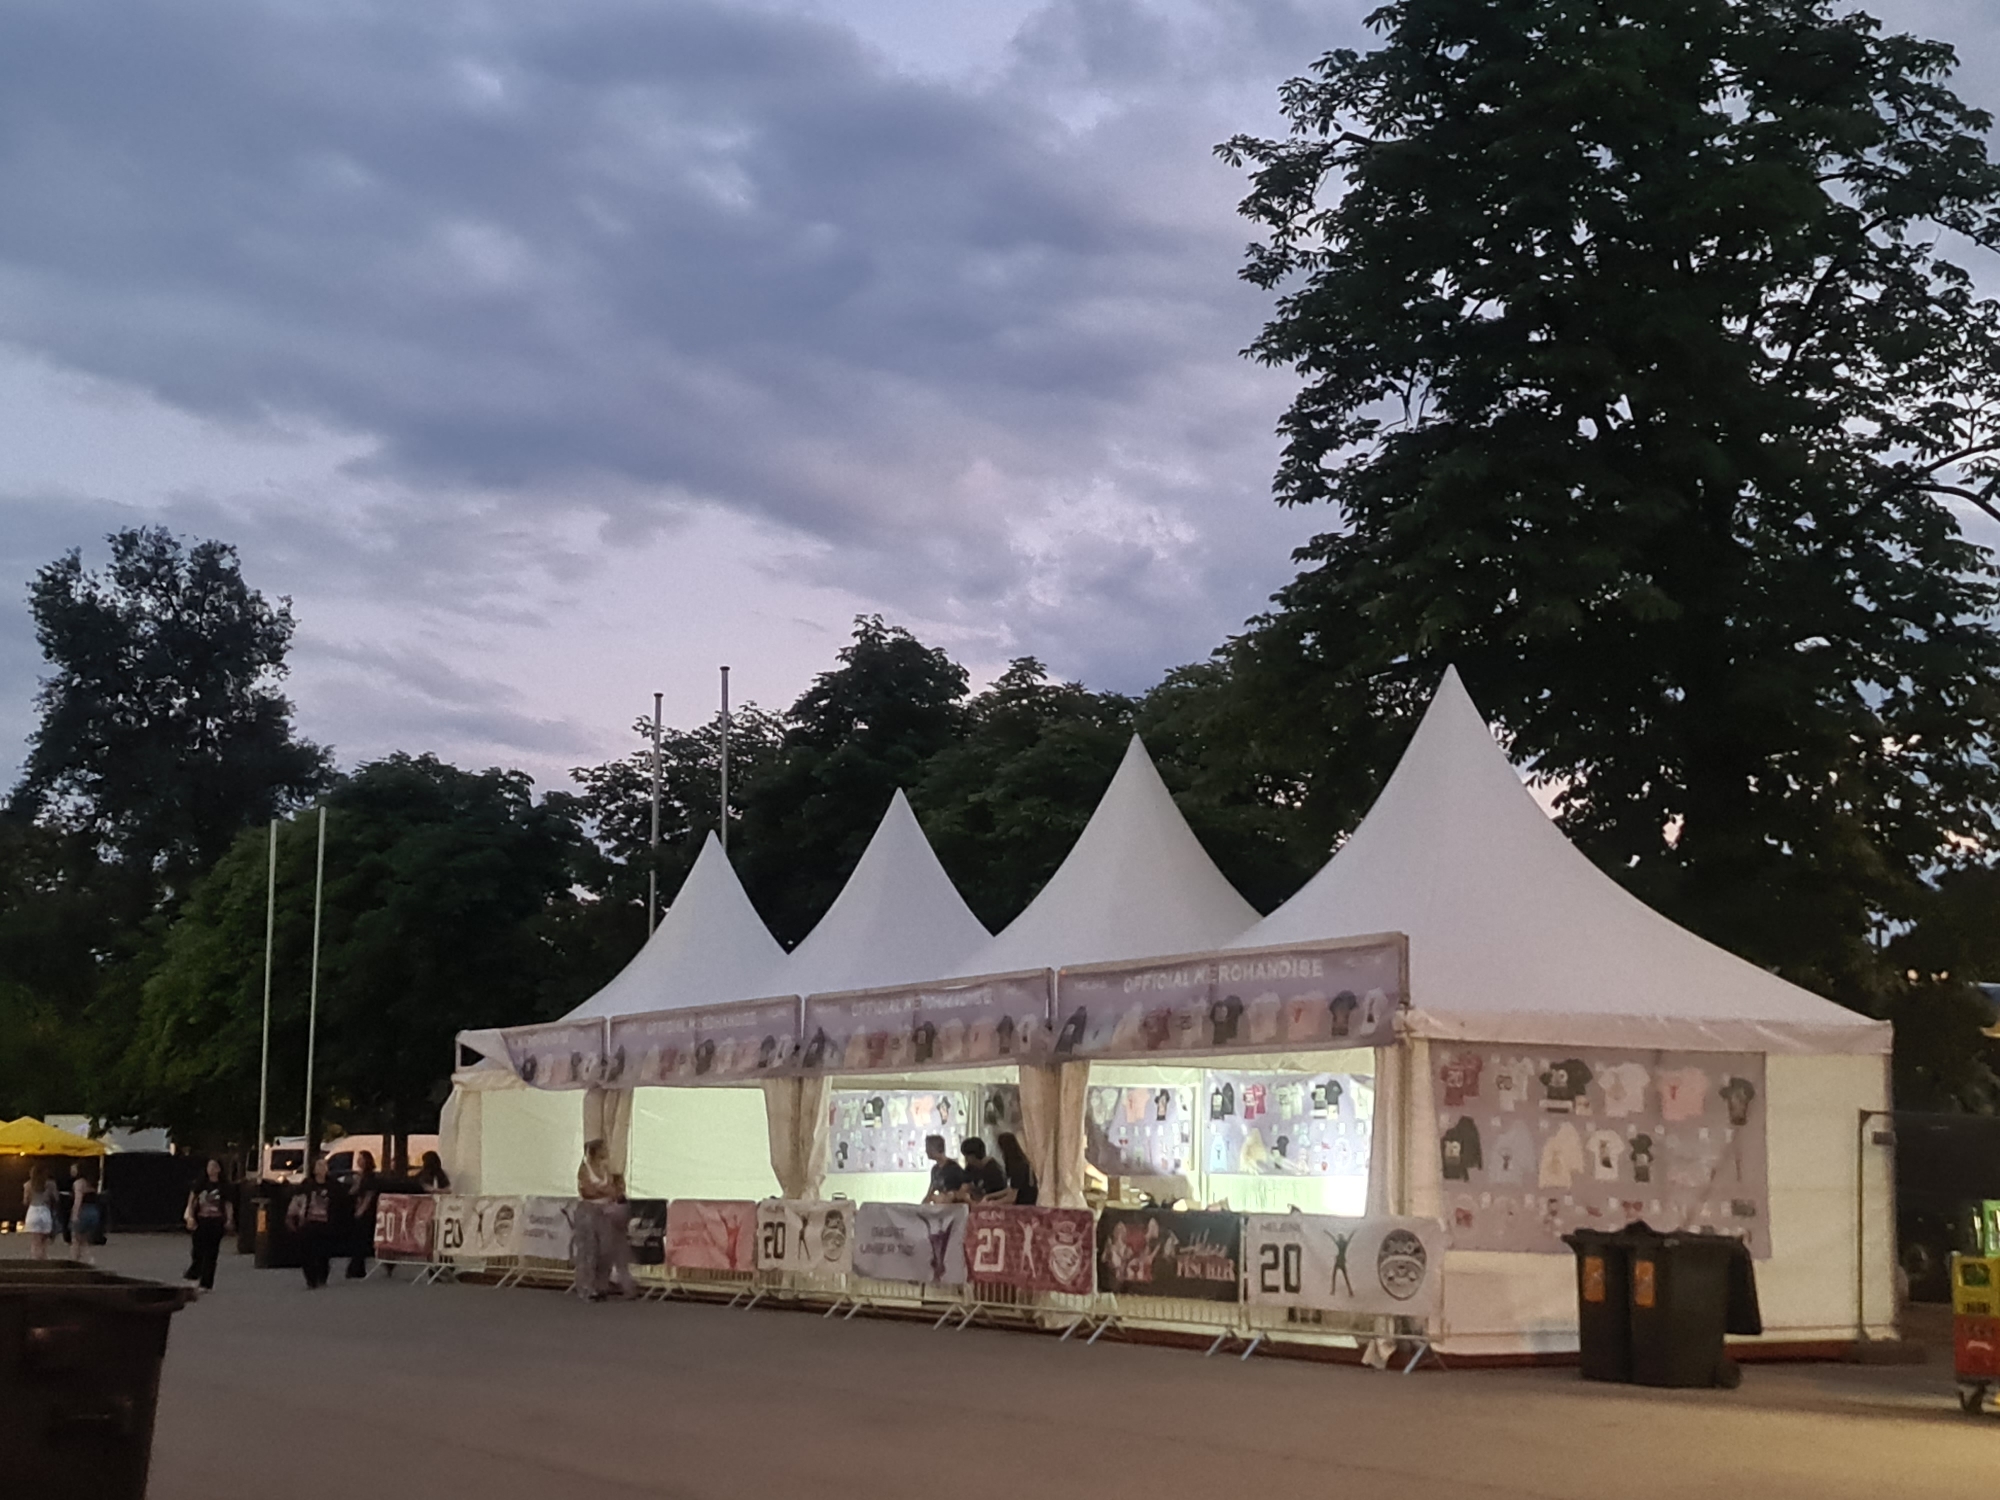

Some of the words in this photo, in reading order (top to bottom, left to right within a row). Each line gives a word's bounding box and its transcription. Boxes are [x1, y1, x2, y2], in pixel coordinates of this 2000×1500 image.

[1123, 970, 1190, 994] OFFICIAL
[1193, 957, 1325, 990] MERCHANDISE
[374, 1211, 395, 1243] 20
[443, 1217, 464, 1249] 20
[763, 1221, 786, 1260] 20
[1259, 1242, 1302, 1294] 20
